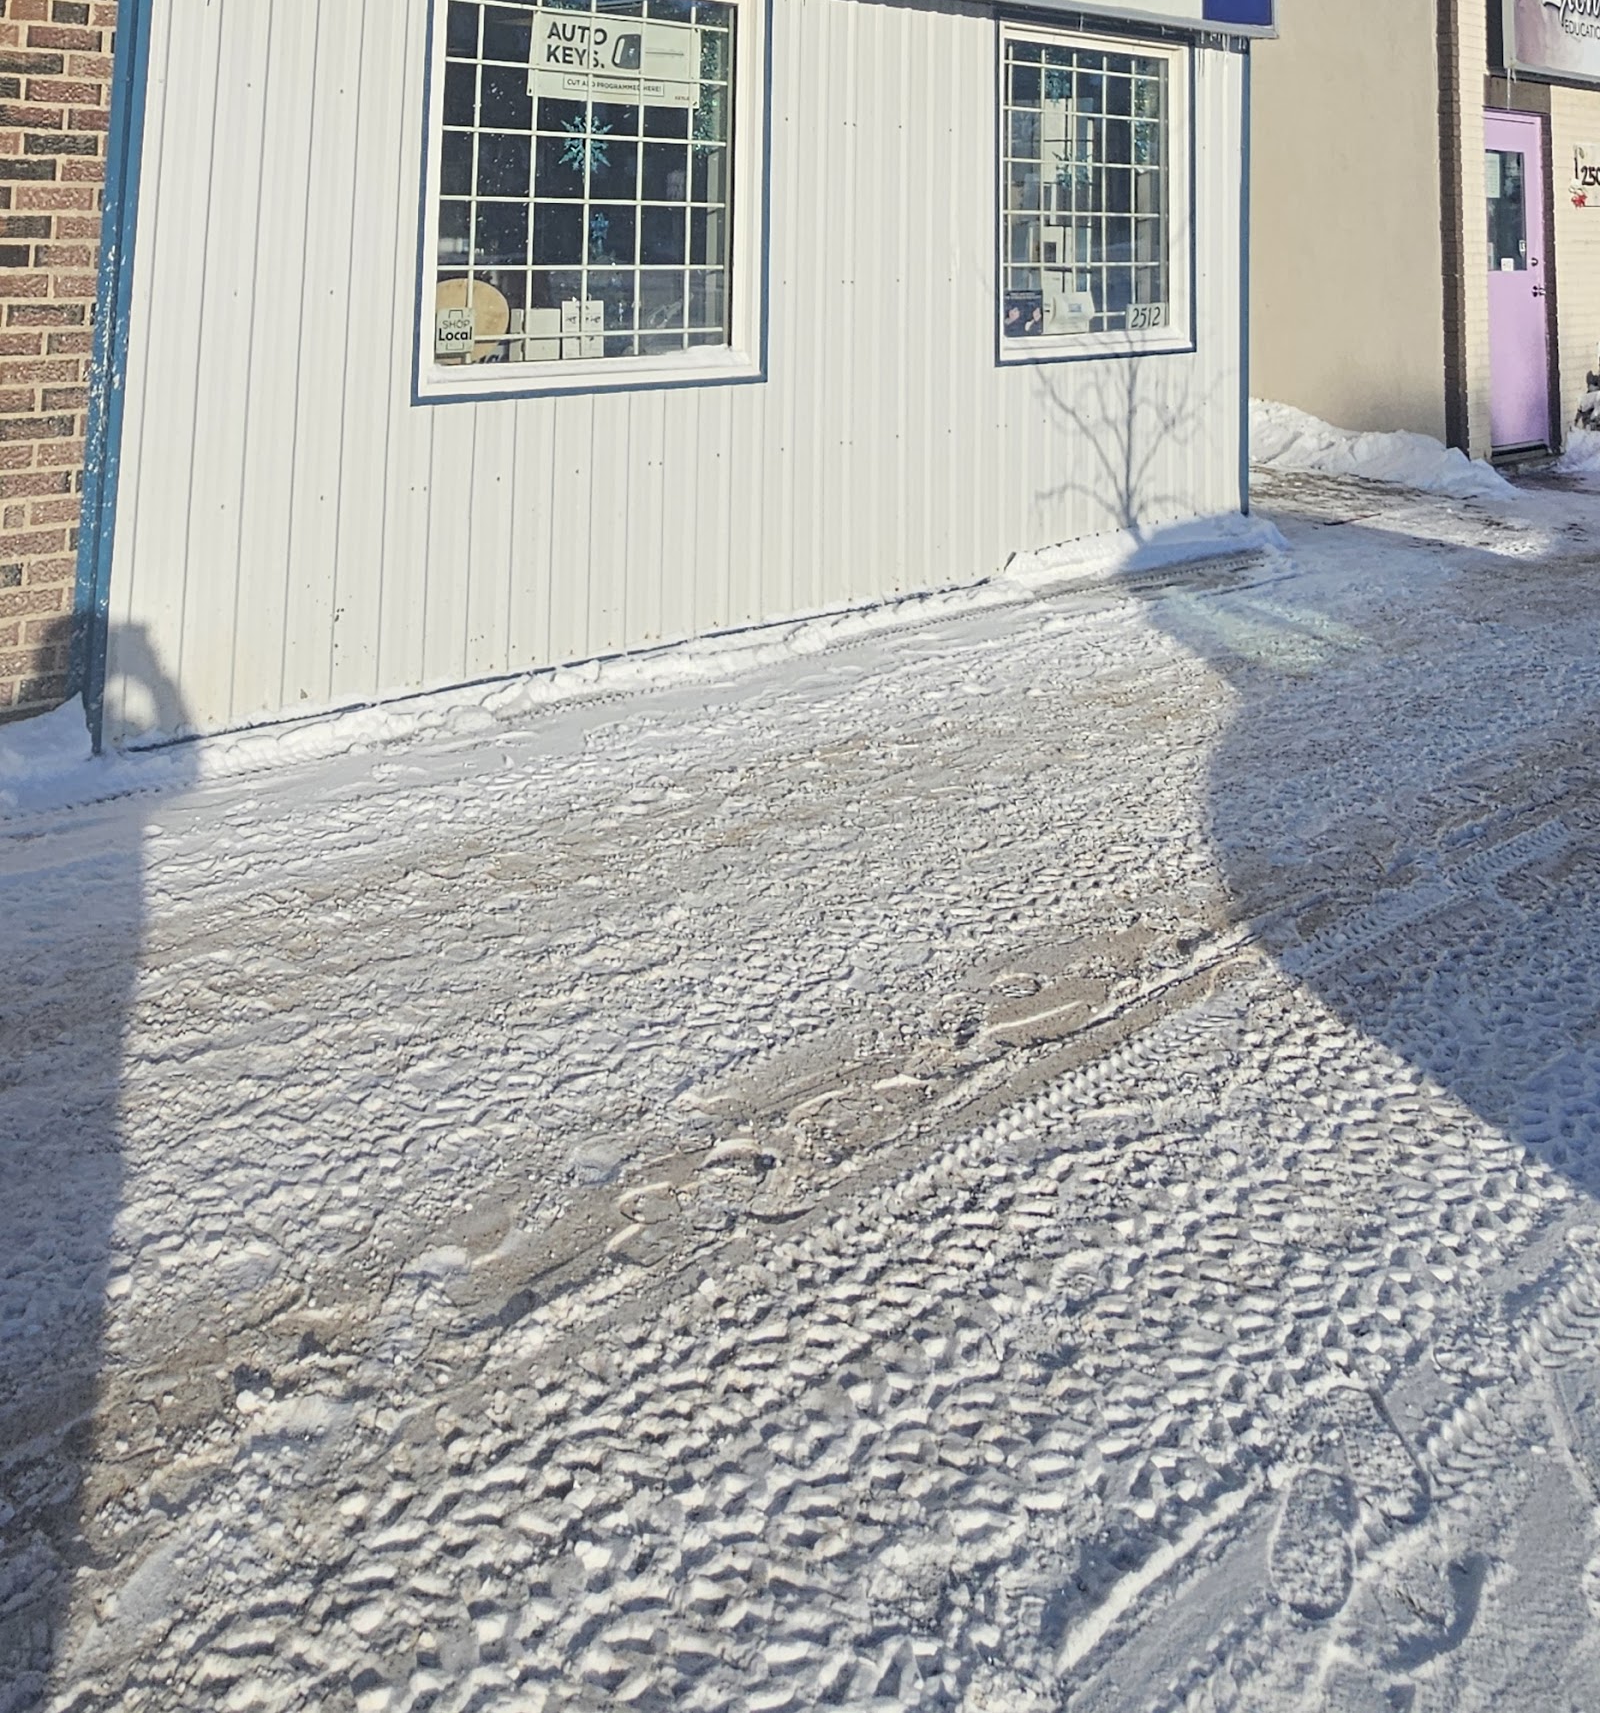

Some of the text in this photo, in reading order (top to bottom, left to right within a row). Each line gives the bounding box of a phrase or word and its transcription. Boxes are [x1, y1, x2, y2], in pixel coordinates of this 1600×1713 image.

[547, 21, 608, 46] AUTO
[582, 80, 596, 88] AD
[442, 318, 471, 330] SHOP
[1131, 306, 1161, 329] 2512
[438, 326, 473, 341] Local
